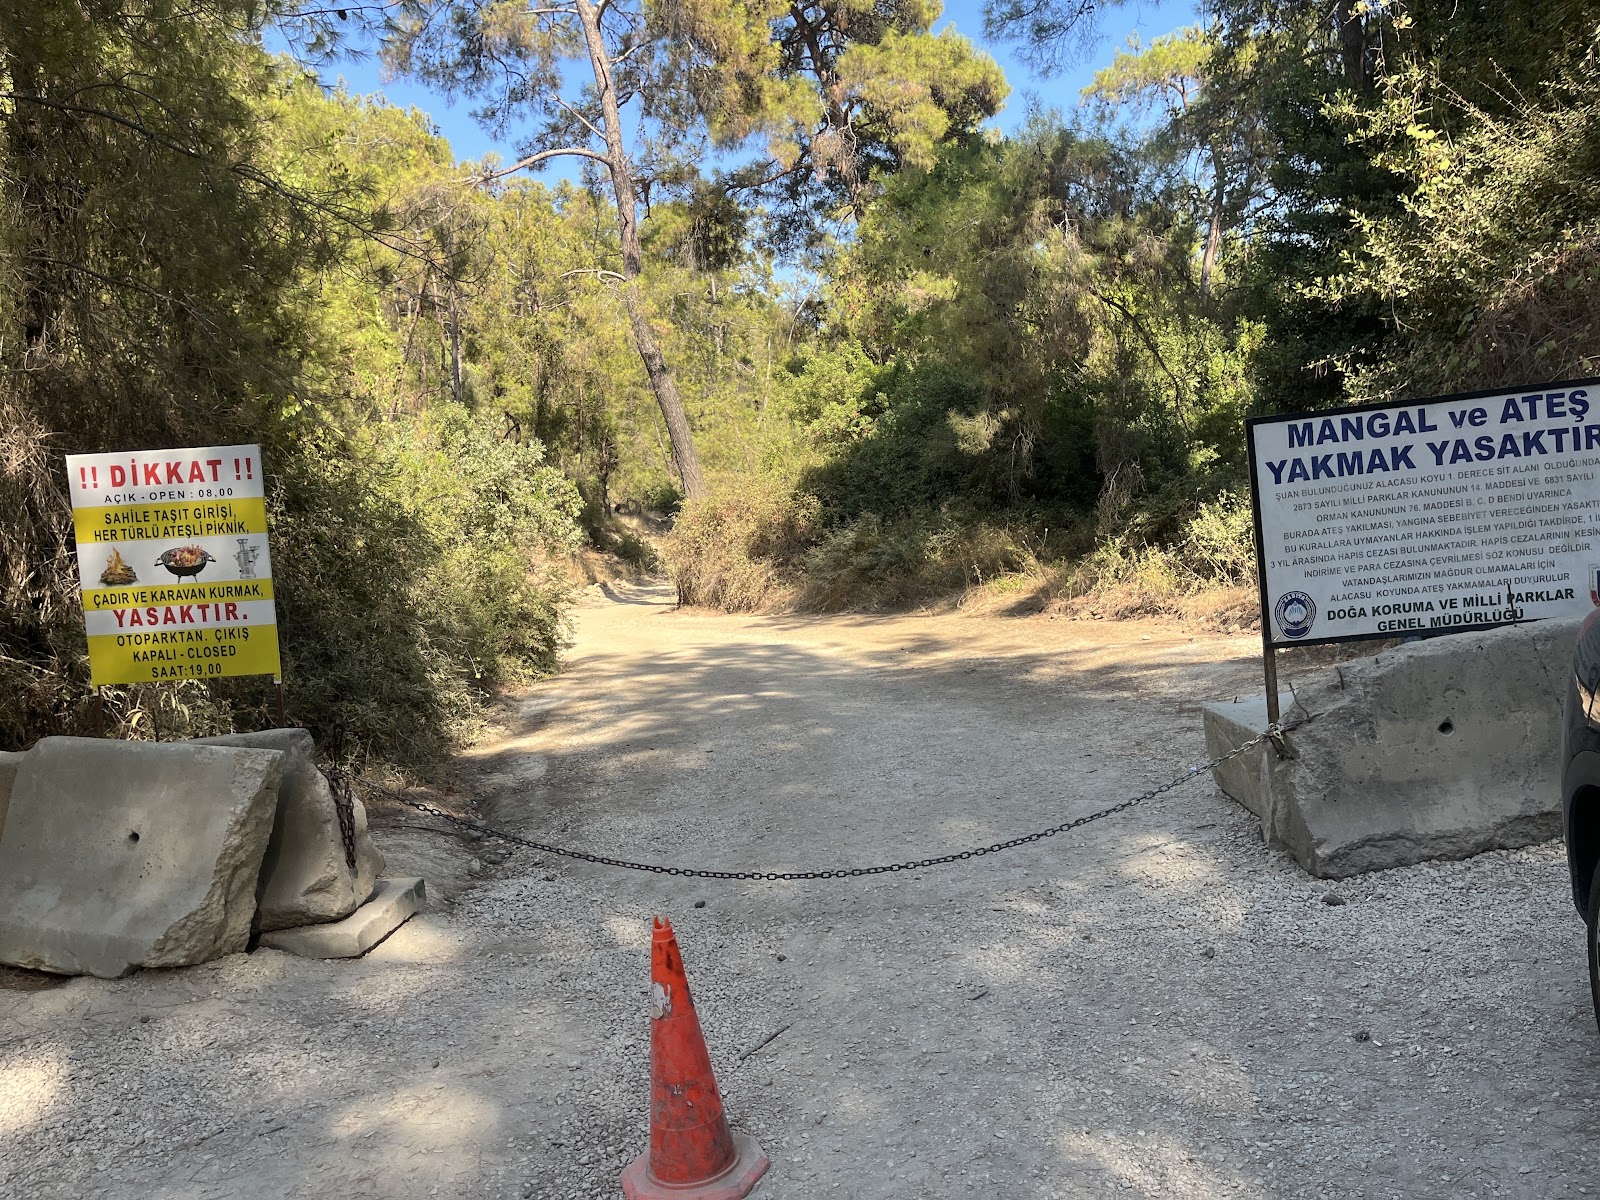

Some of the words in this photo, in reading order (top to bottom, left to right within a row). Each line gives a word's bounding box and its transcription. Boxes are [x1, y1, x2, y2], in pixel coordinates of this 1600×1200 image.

[1288, 408, 1437, 448] MANGAL
[1448, 407, 1487, 428] ve
[1500, 390, 1590, 424] ATEŞ
[80, 467, 98, 489] !!
[110, 459, 222, 488] DİKKAT
[234, 458, 252, 480] !!
[1265, 445, 1416, 484] YAKMAK
[105, 494, 136, 504] AÇIK
[150, 490, 185, 500] OPEN
[1276, 490, 1299, 501] ŞUAN
[1302, 482, 1374, 496] BULUNDUĞUNUZ
[1376, 477, 1418, 488] ALACASU
[1420, 474, 1445, 483] KOYU
[1458, 468, 1494, 479] DERECE
[1497, 466, 1510, 474] SİT
[1512, 464, 1539, 473] ALANI
[1293, 503, 1312, 511] 2873
[1315, 500, 1340, 509] SAYILI
[1343, 495, 1365, 505] MİLLİ
[1368, 492, 1408, 503] PARKLAR
[1412, 485, 1468, 498] KANUNUNUN
[1486, 478, 1525, 490] MADDESİ
[1528, 478, 1539, 486] VE
[1544, 475, 1564, 484] 6831
[1567, 473, 1594, 482] SAYILI
[105, 508, 149, 524] SAHİLE
[154, 508, 188, 523] TAŞIT
[1316, 512, 1348, 522] ORMAN
[1351, 506, 1406, 518] KANUNUNUN
[1424, 498, 1463, 510] MADDESİ
[1497, 491, 1524, 503] BENDİ
[1527, 489, 1572, 500] UYARINCA
[94, 528, 118, 542] HER
[121, 524, 158, 540] TÜRLÜ
[163, 522, 202, 538] ATEŞLİ
[1284, 529, 1319, 539] BURADA
[1321, 526, 1343, 535] ATEŞ
[1396, 516, 1435, 527] YANGINA
[1438, 511, 1487, 523] SEBEBİYET
[1489, 504, 1559, 517] VERECEĞİNDEN
[1285, 545, 1296, 553] BU
[1299, 539, 1352, 551] KURALLARA
[1354, 532, 1413, 545] UYMAYANLAR
[1416, 528, 1462, 539] HAKKINDA
[1464, 524, 1491, 535] İŞLEM
[1494, 519, 1536, 531] YAPILDIĞI
[1277, 558, 1290, 567] YIL
[1292, 554, 1336, 566] ARASINDA
[1338, 549, 1364, 560] HAPİS
[1366, 548, 1398, 558] CEZASI
[1482, 536, 1508, 546] HAPİS
[1511, 531, 1569, 543] CEZALARININ
[1304, 567, 1341, 578] İNDİRİME
[1358, 563, 1381, 572] PARA
[1384, 559, 1427, 569] CEZASINA
[1430, 550, 1483, 566] ÇEVRİLMESİ
[1486, 550, 1503, 559] SÖZ
[1506, 547, 1544, 557] KONUSU
[1330, 592, 1371, 602] ALACASU
[1376, 587, 1420, 597] KOYUNDA
[1422, 584, 1444, 593] ATEŞ
[1446, 578, 1511, 590] YAKMAMALARI
[1514, 573, 1570, 585] DUYURULUR
[1342, 572, 1431, 587] VATANDAŞLARIMIZIN
[1434, 568, 1473, 578] MAĞDUR
[1476, 562, 1535, 574] OLMAMALARI
[1537, 560, 1555, 570] İÇİN
[93, 593, 129, 608] ÇADIR
[132, 591, 147, 602] VE
[151, 588, 206, 602] KARAVAN
[1327, 606, 1367, 620] DOĞA
[1372, 601, 1434, 616] KORUMA
[1439, 598, 1458, 610] VE
[1463, 592, 1501, 607] MİLLİ
[1507, 588, 1574, 604] PARKLAR
[1377, 618, 1425, 631] GENEL
[1430, 606, 1524, 627] MÜDÜRLÜĞÜ
[215, 628, 249, 643] ÇIKIŞ
[133, 649, 177, 662] KAPALI
[188, 646, 236, 659] CLOSED
